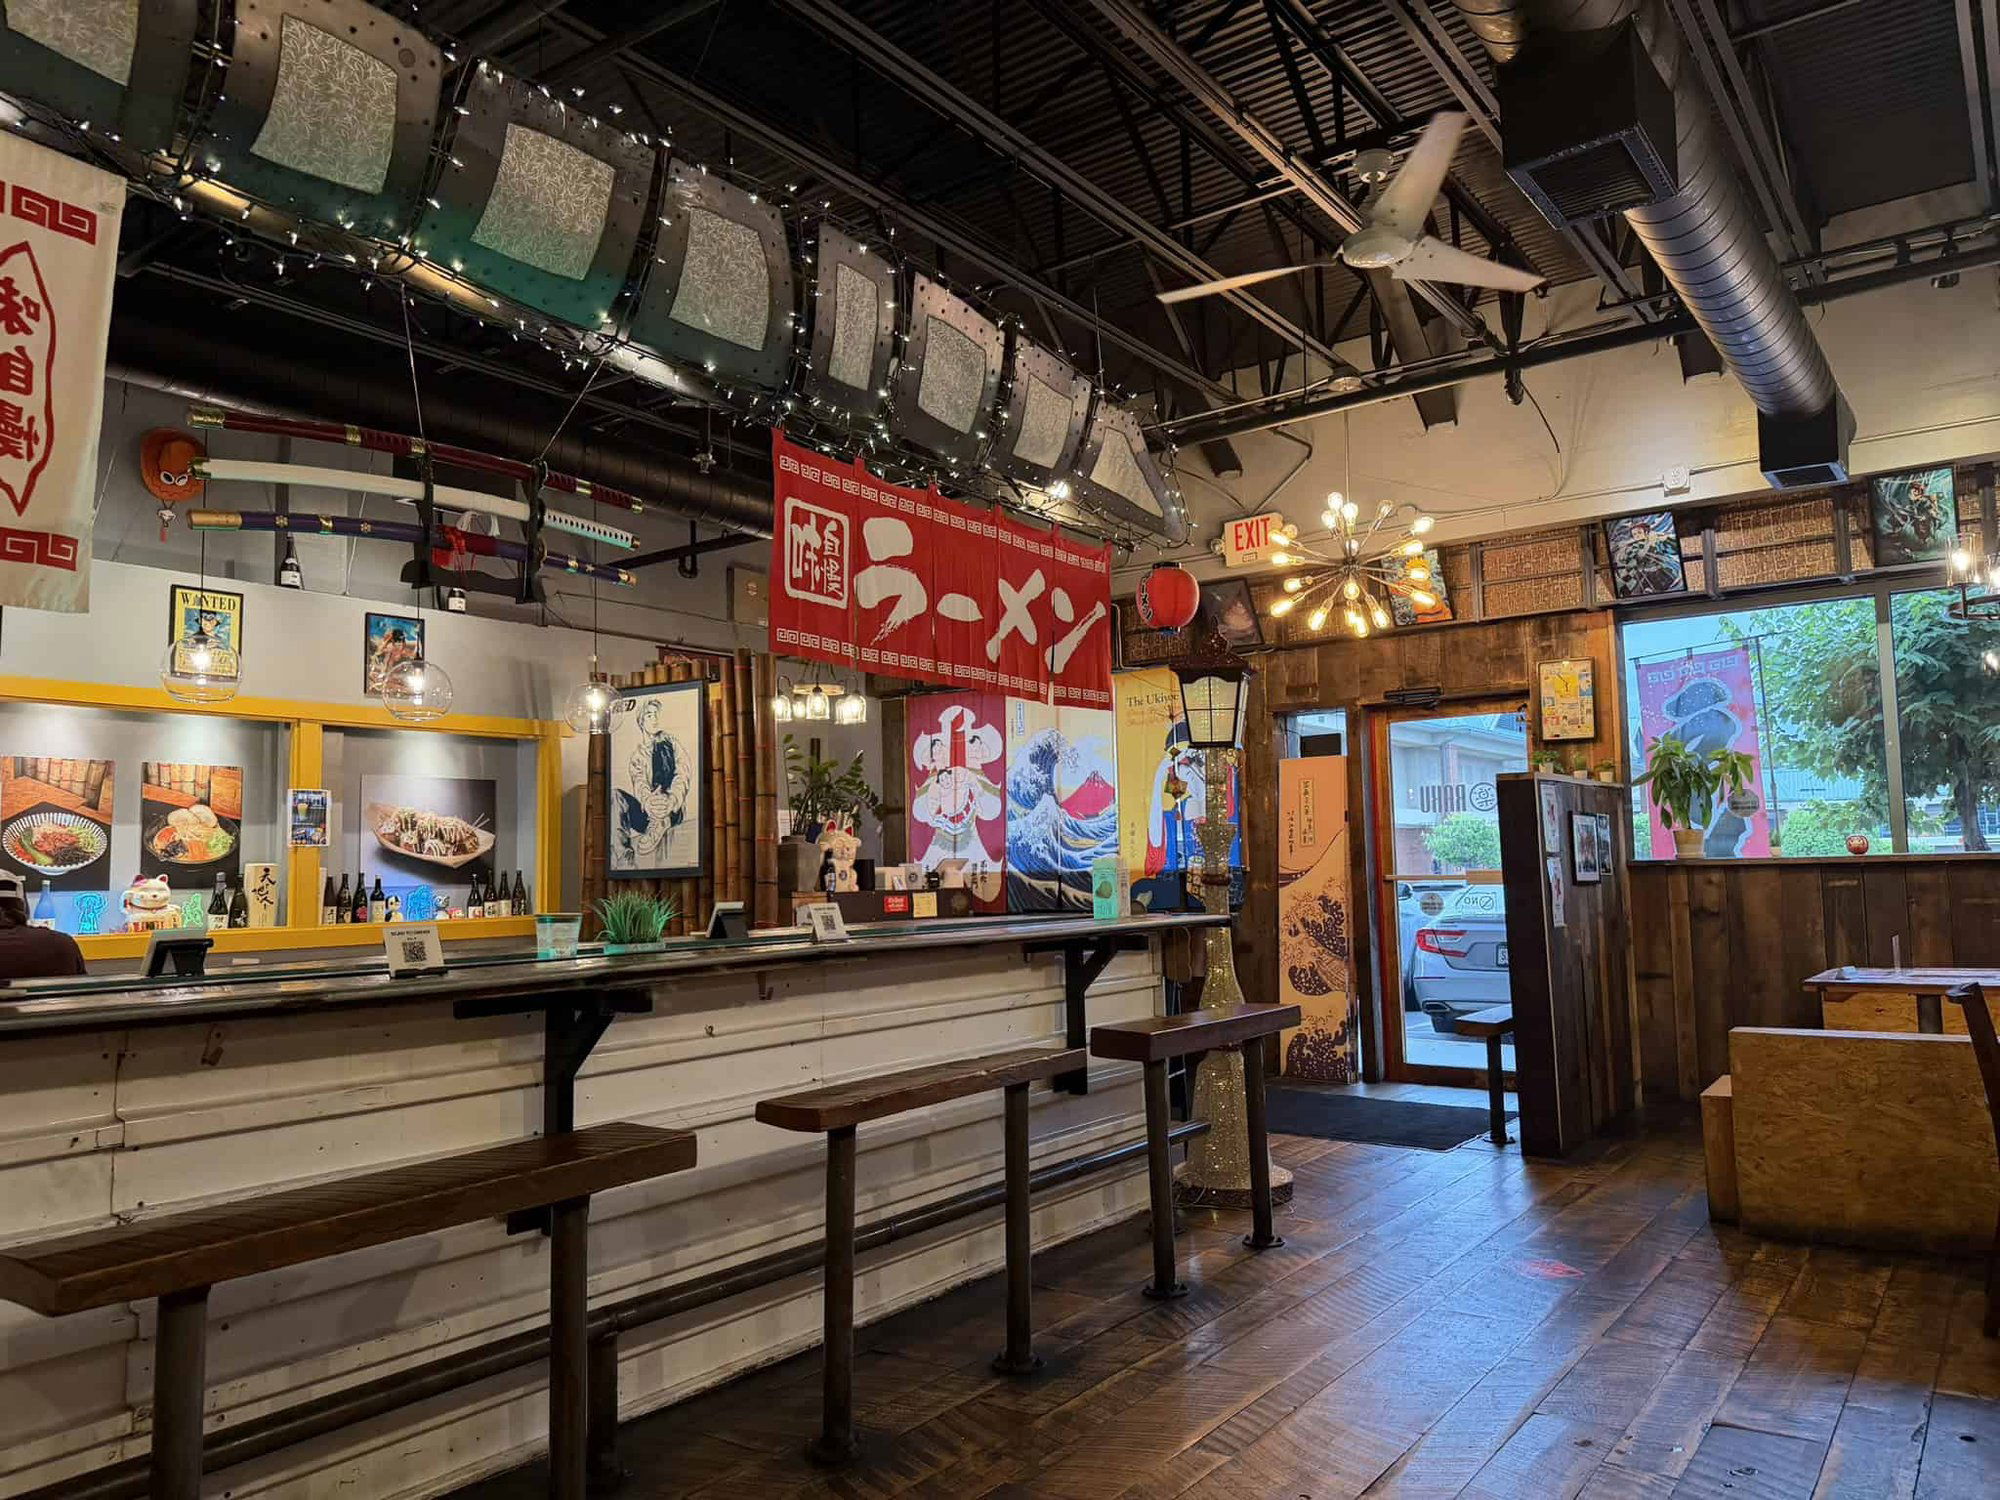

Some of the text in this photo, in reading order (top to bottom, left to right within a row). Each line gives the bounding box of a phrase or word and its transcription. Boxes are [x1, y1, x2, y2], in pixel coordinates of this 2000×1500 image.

[1234, 516, 1270, 552] EXIT
[853, 516, 1106, 673] ラーメン
[1126, 695, 1143, 707] The
